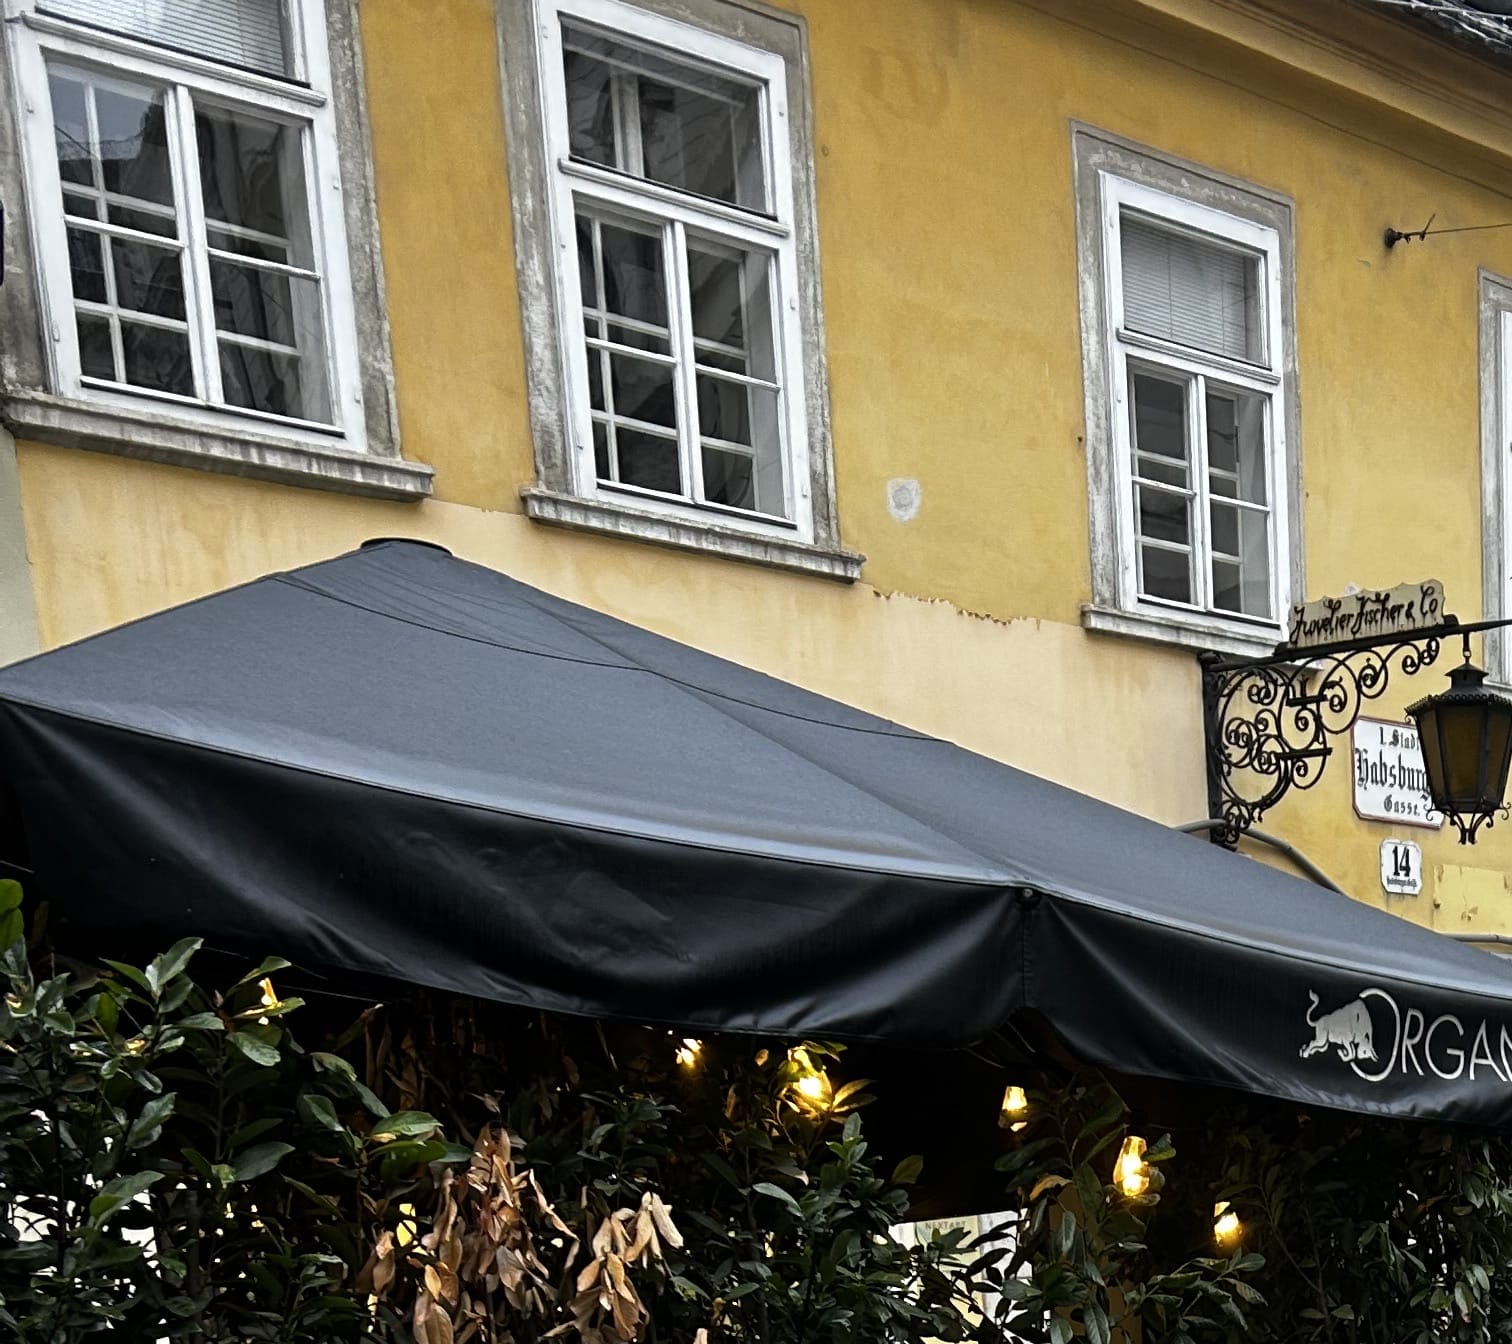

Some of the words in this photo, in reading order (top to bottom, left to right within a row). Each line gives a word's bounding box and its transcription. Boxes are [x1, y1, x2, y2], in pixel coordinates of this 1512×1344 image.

[1351, 592, 1404, 634] Fischer
[1420, 584, 1438, 614] Co
[1355, 748, 1432, 802] Habsburg
[1392, 845, 1411, 877] 14
